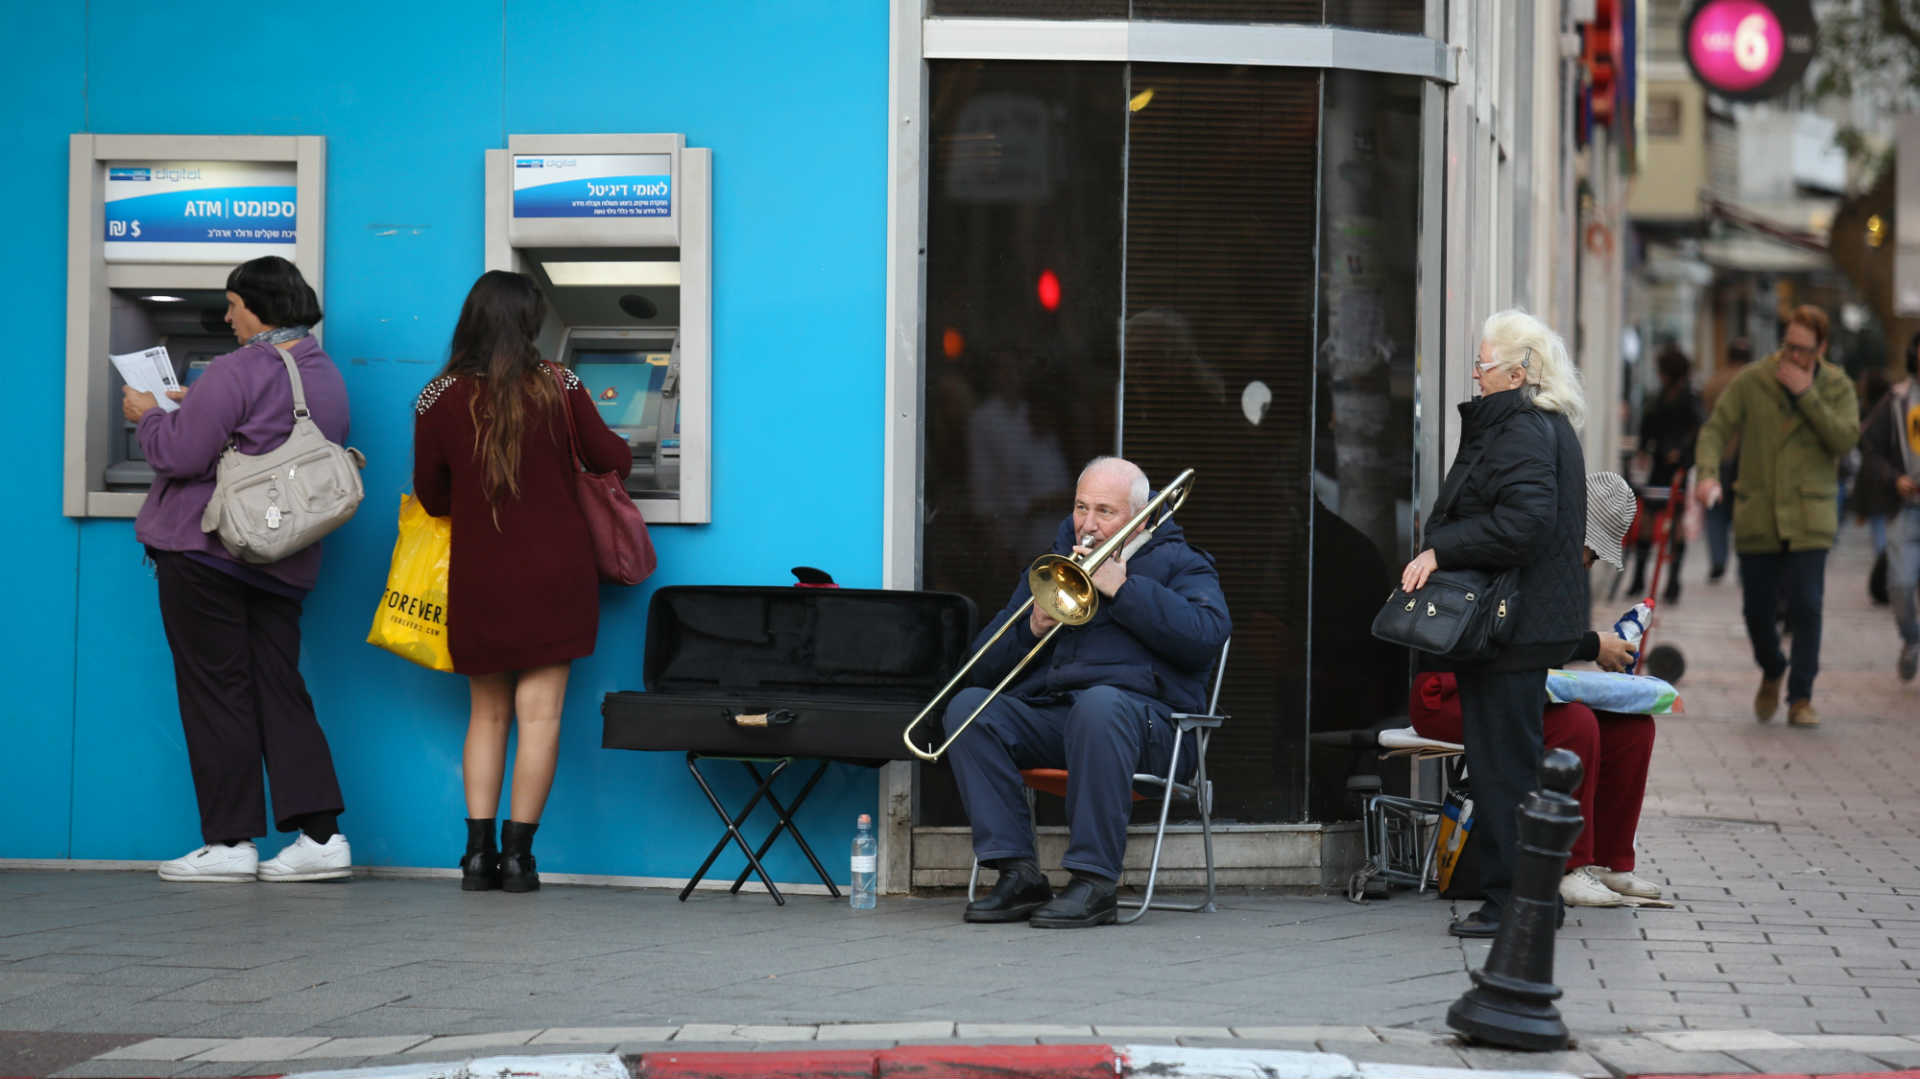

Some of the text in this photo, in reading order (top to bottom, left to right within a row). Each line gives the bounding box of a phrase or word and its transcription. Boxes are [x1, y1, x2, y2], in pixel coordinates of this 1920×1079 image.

[1733, 12, 1769, 73] 6
[155, 167, 202, 182] digital
[587, 181, 668, 197] לאומי דיגיטל
[184, 200, 222, 217] ATM
[130, 219, 142, 238] $
